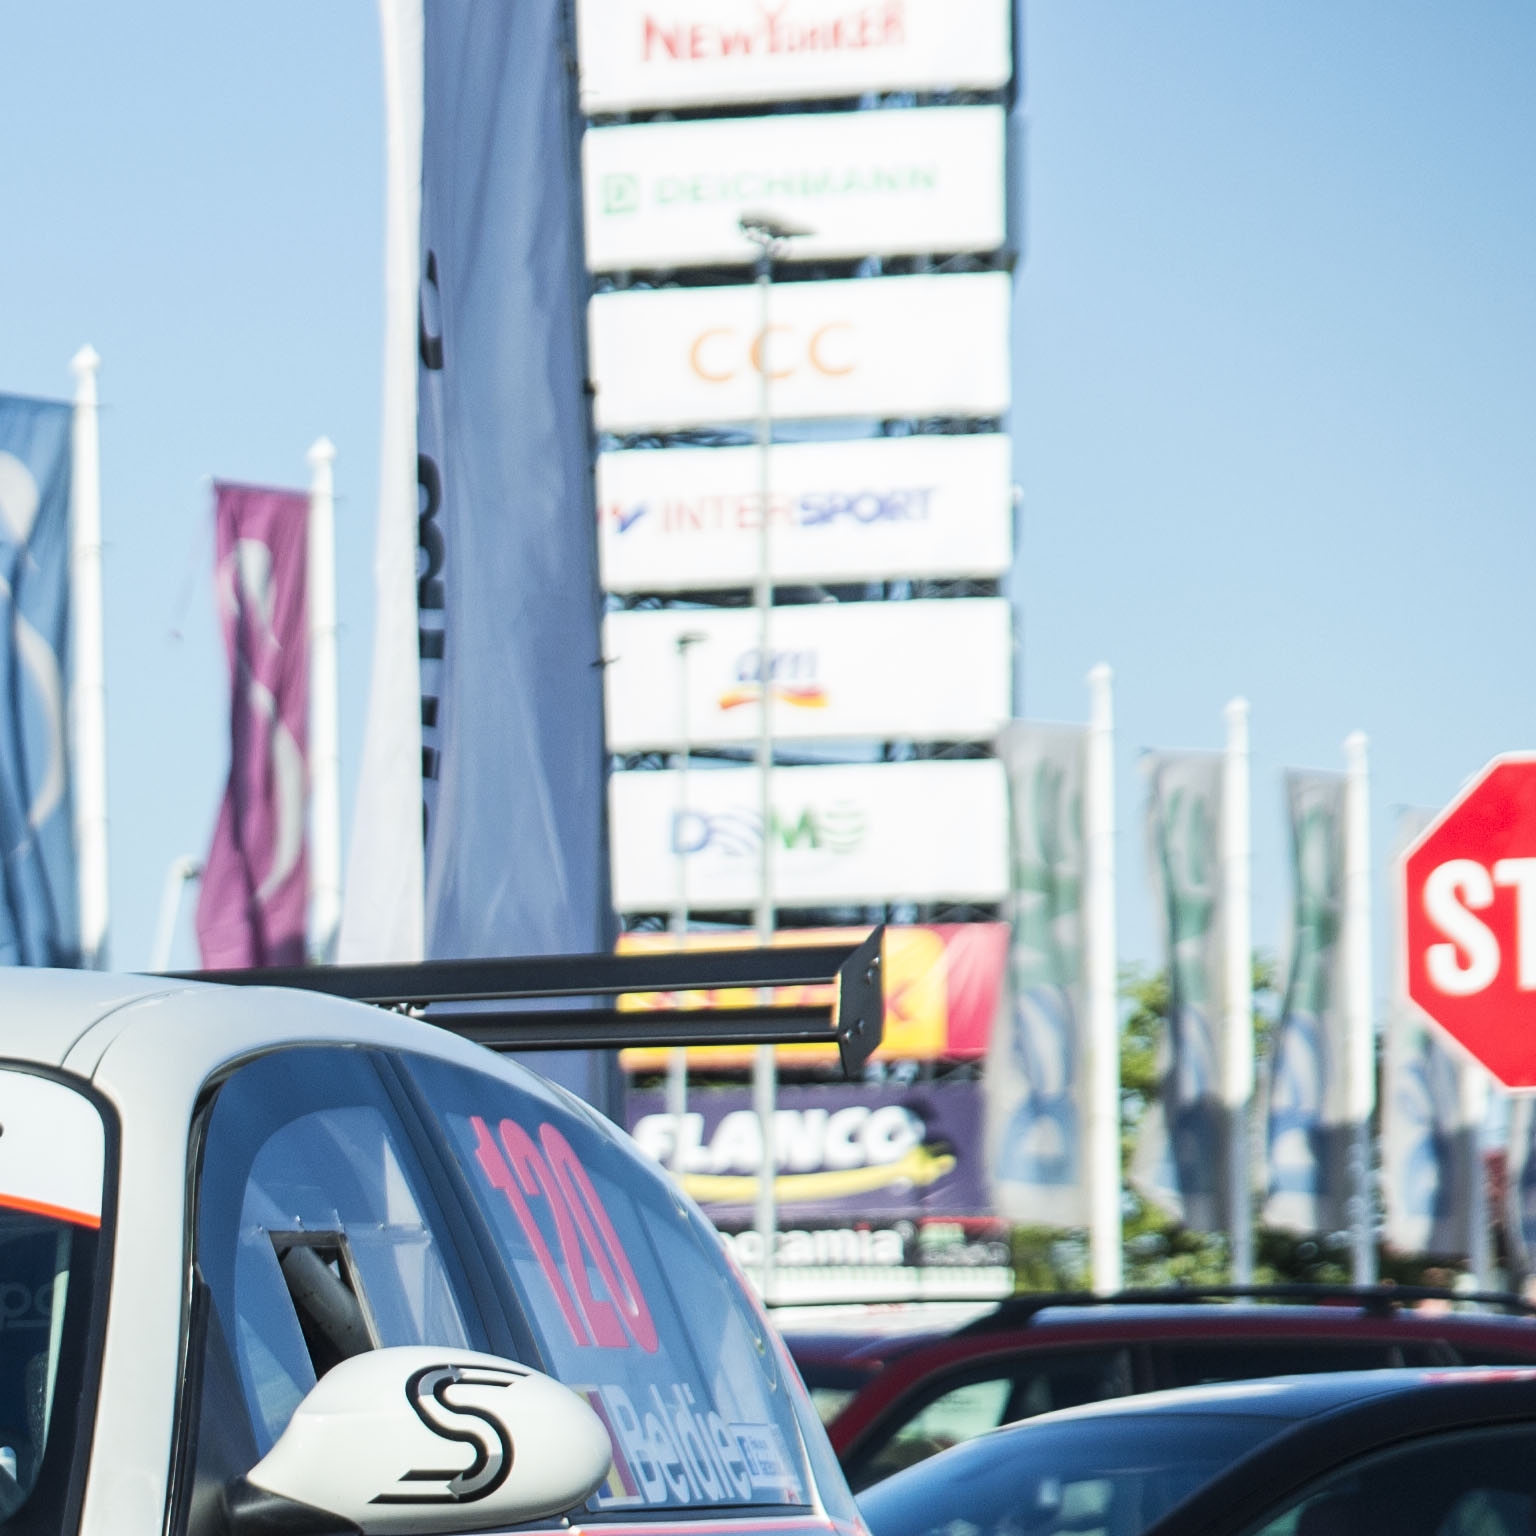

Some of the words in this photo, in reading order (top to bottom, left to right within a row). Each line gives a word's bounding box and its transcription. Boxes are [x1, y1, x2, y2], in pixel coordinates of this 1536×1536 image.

[652, 163, 939, 205] DEICHMANN
[689, 321, 857, 382] CCC
[662, 485, 937, 533] INTERSPORT
[634, 1105, 921, 1173] FLANCO
[470, 1116, 658, 1353] 120
